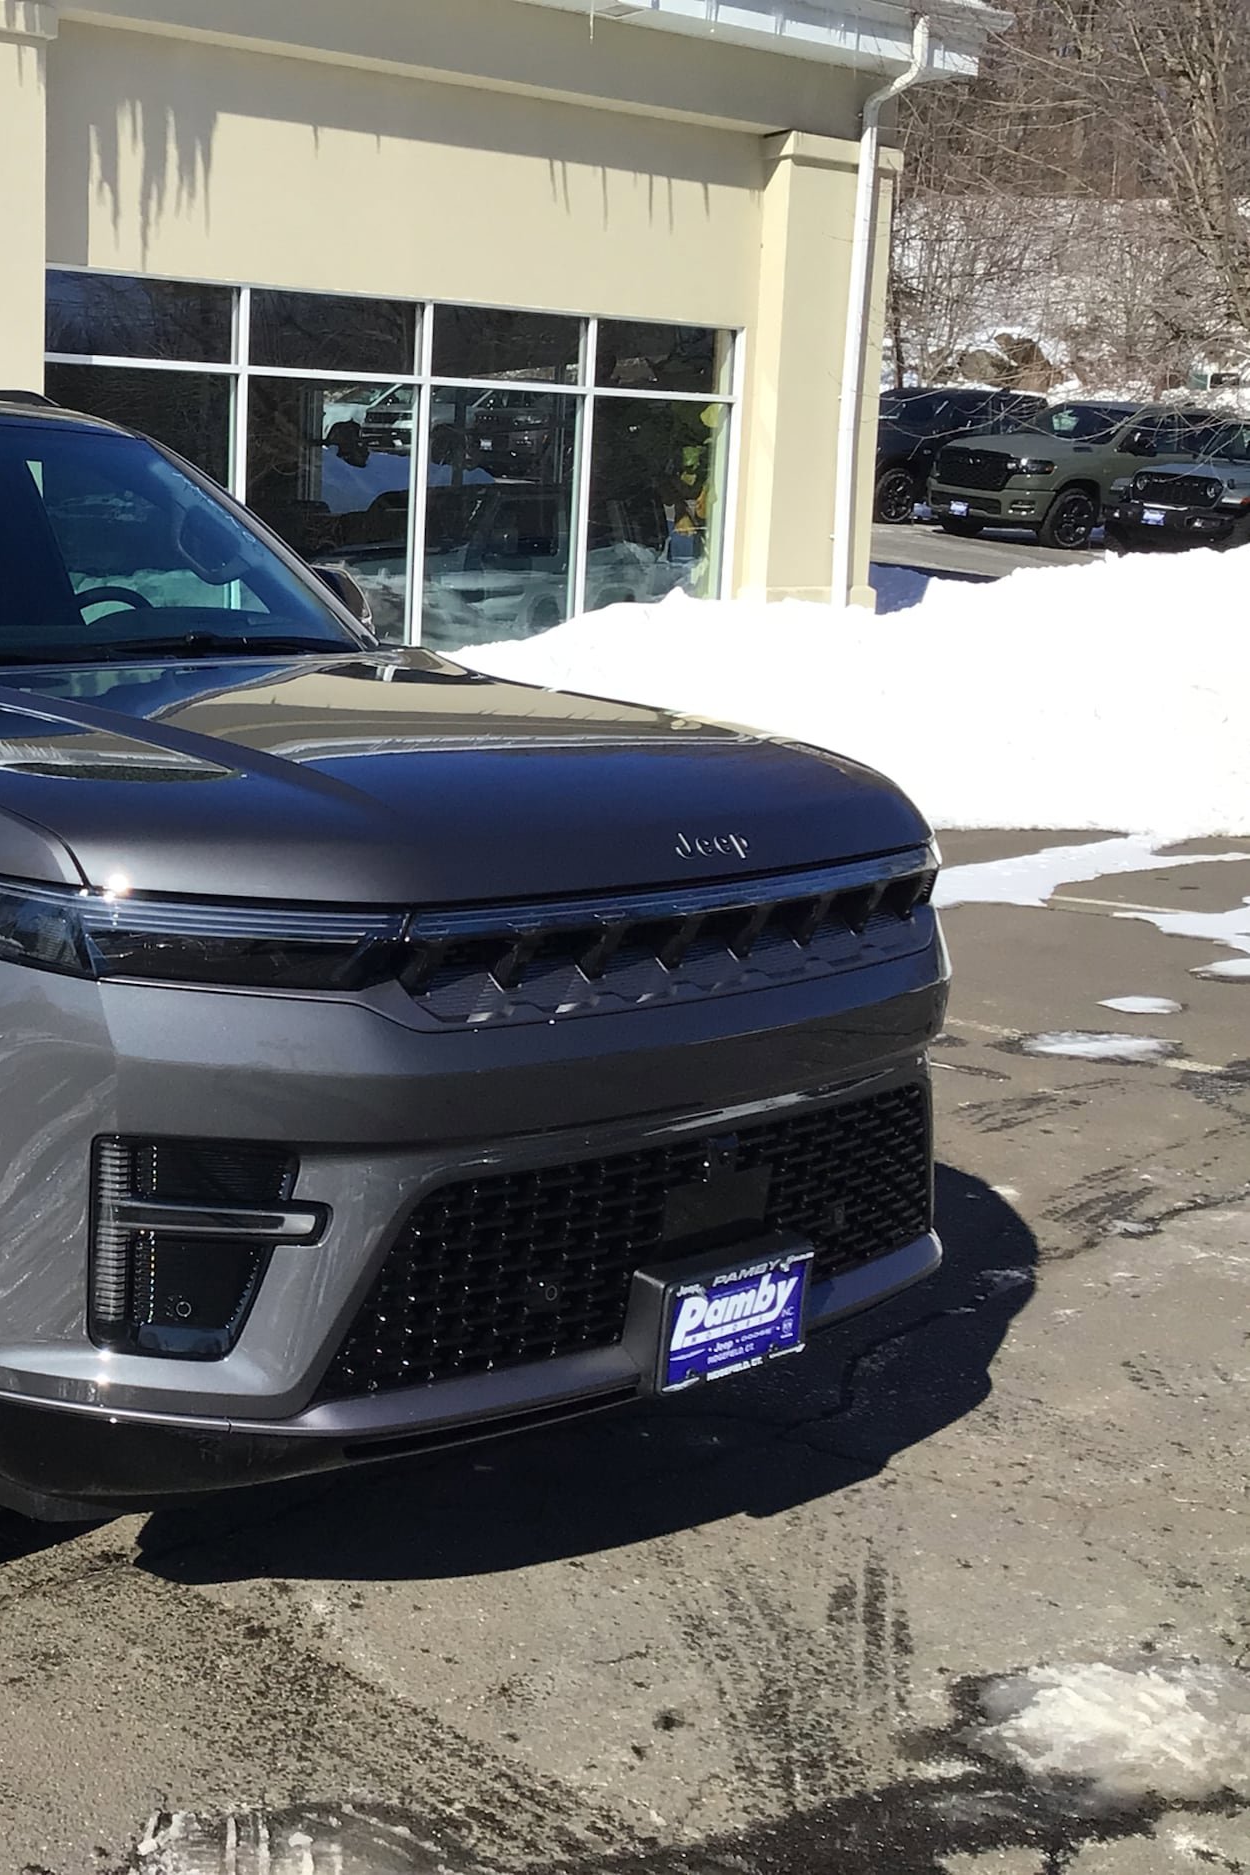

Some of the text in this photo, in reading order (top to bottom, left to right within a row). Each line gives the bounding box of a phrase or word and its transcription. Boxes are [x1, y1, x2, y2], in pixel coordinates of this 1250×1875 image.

[675, 832, 750, 859] Jeep
[712, 1259, 781, 1287] PAMBY
[670, 1272, 799, 1351] Pamby
